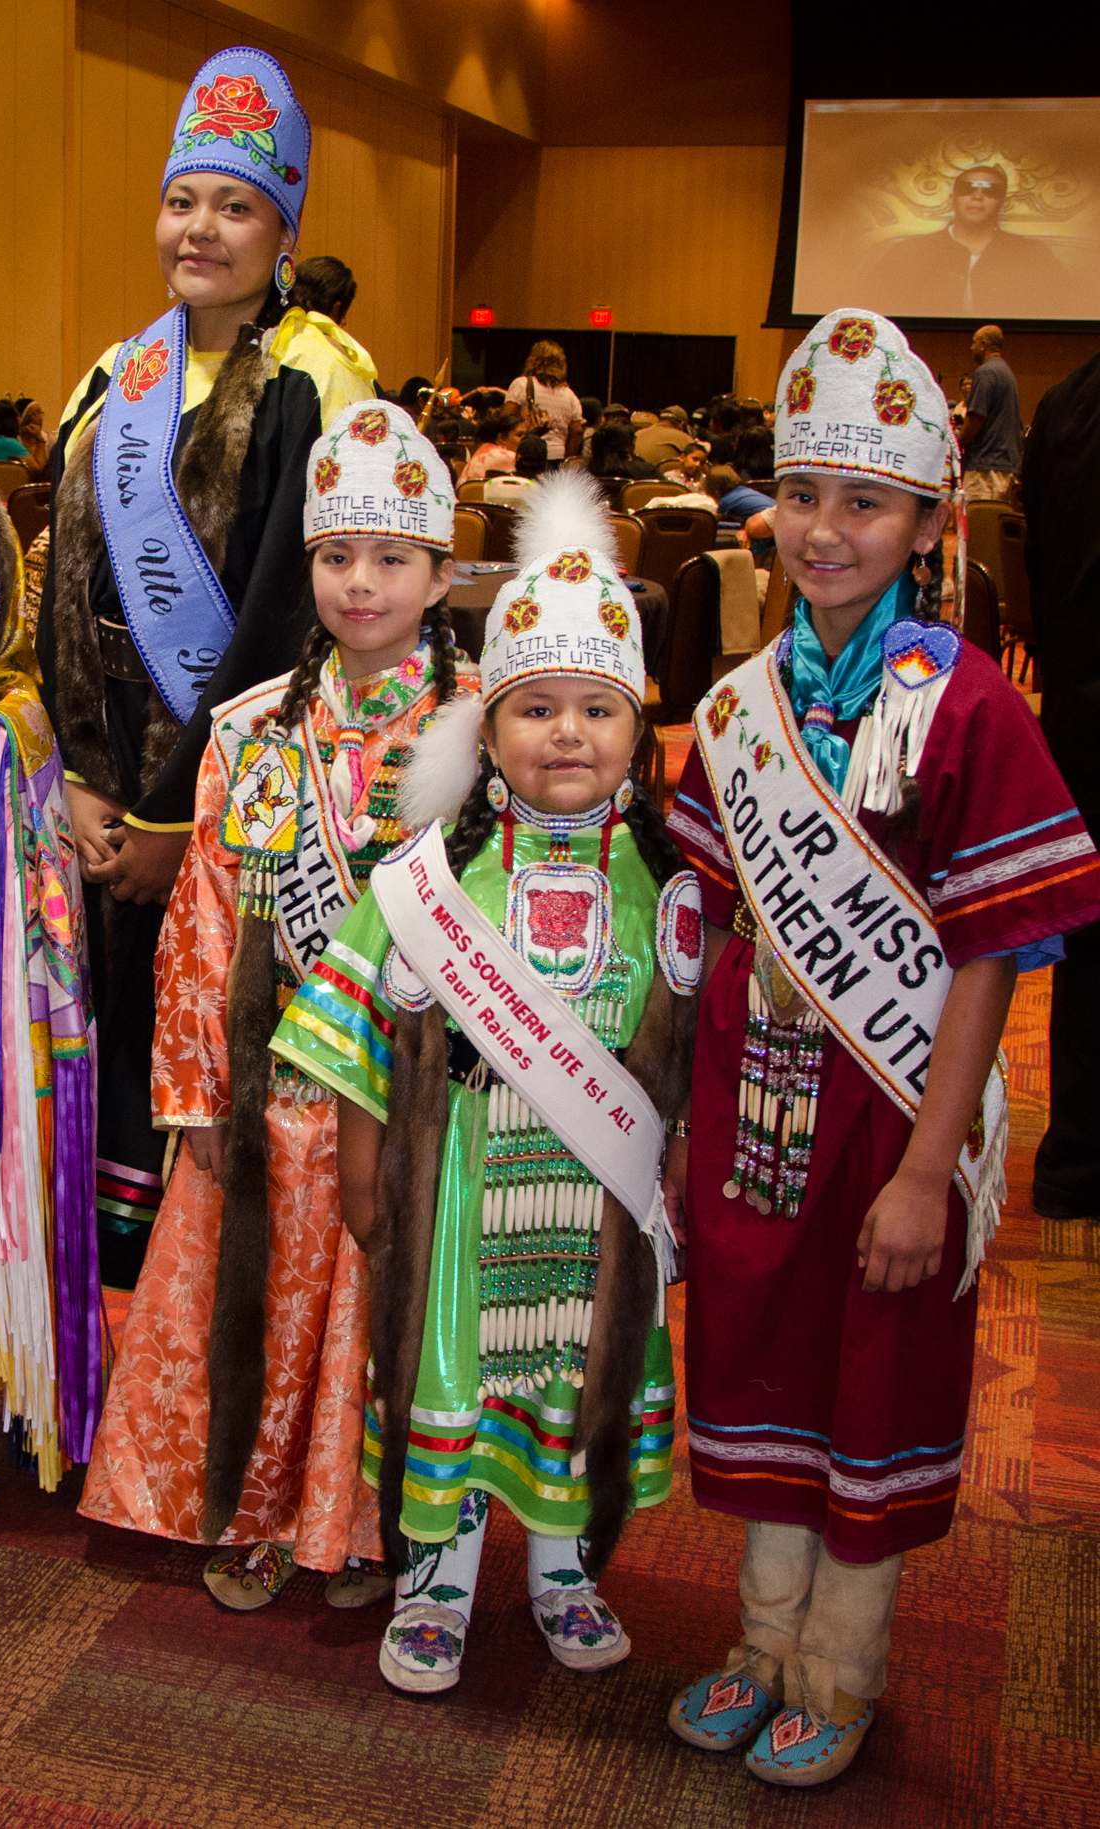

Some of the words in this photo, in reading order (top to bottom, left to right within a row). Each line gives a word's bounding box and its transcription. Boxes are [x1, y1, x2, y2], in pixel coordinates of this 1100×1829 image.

[790, 421, 816, 439] JR.
[826, 422, 883, 445] MISS
[777, 440, 859, 460] SOUTHERN
[869, 448, 907, 470] UTE
[116, 422, 150, 509] Miss
[135, 537, 184, 616] Ute
[312, 511, 391, 532] SOUTHERN
[400, 515, 428, 534] UTE
[318, 495, 375, 514] LITTLE
[384, 496, 428, 517] MISS
[506, 634, 569, 660] LITTLE
[577, 635, 621, 658] MISS
[488, 650, 561, 688] SOUTHERN
[570, 650, 606, 669] UTE
[724, 767, 871, 1001] SOUTHERN
[778, 808, 839, 884] JR.
[830, 873, 944, 990] MISS
[408, 855, 436, 906] LITTLE
[431, 903, 472, 953] MISS
[469, 951, 552, 1044] SOUTHERN
[550, 1041, 585, 1078] UTE
[583, 1076, 608, 1105] 1st
[608, 1105, 636, 1136] ALT.
[439, 958, 482, 1008] Tauri
[477, 1006, 533, 1071] Raines
